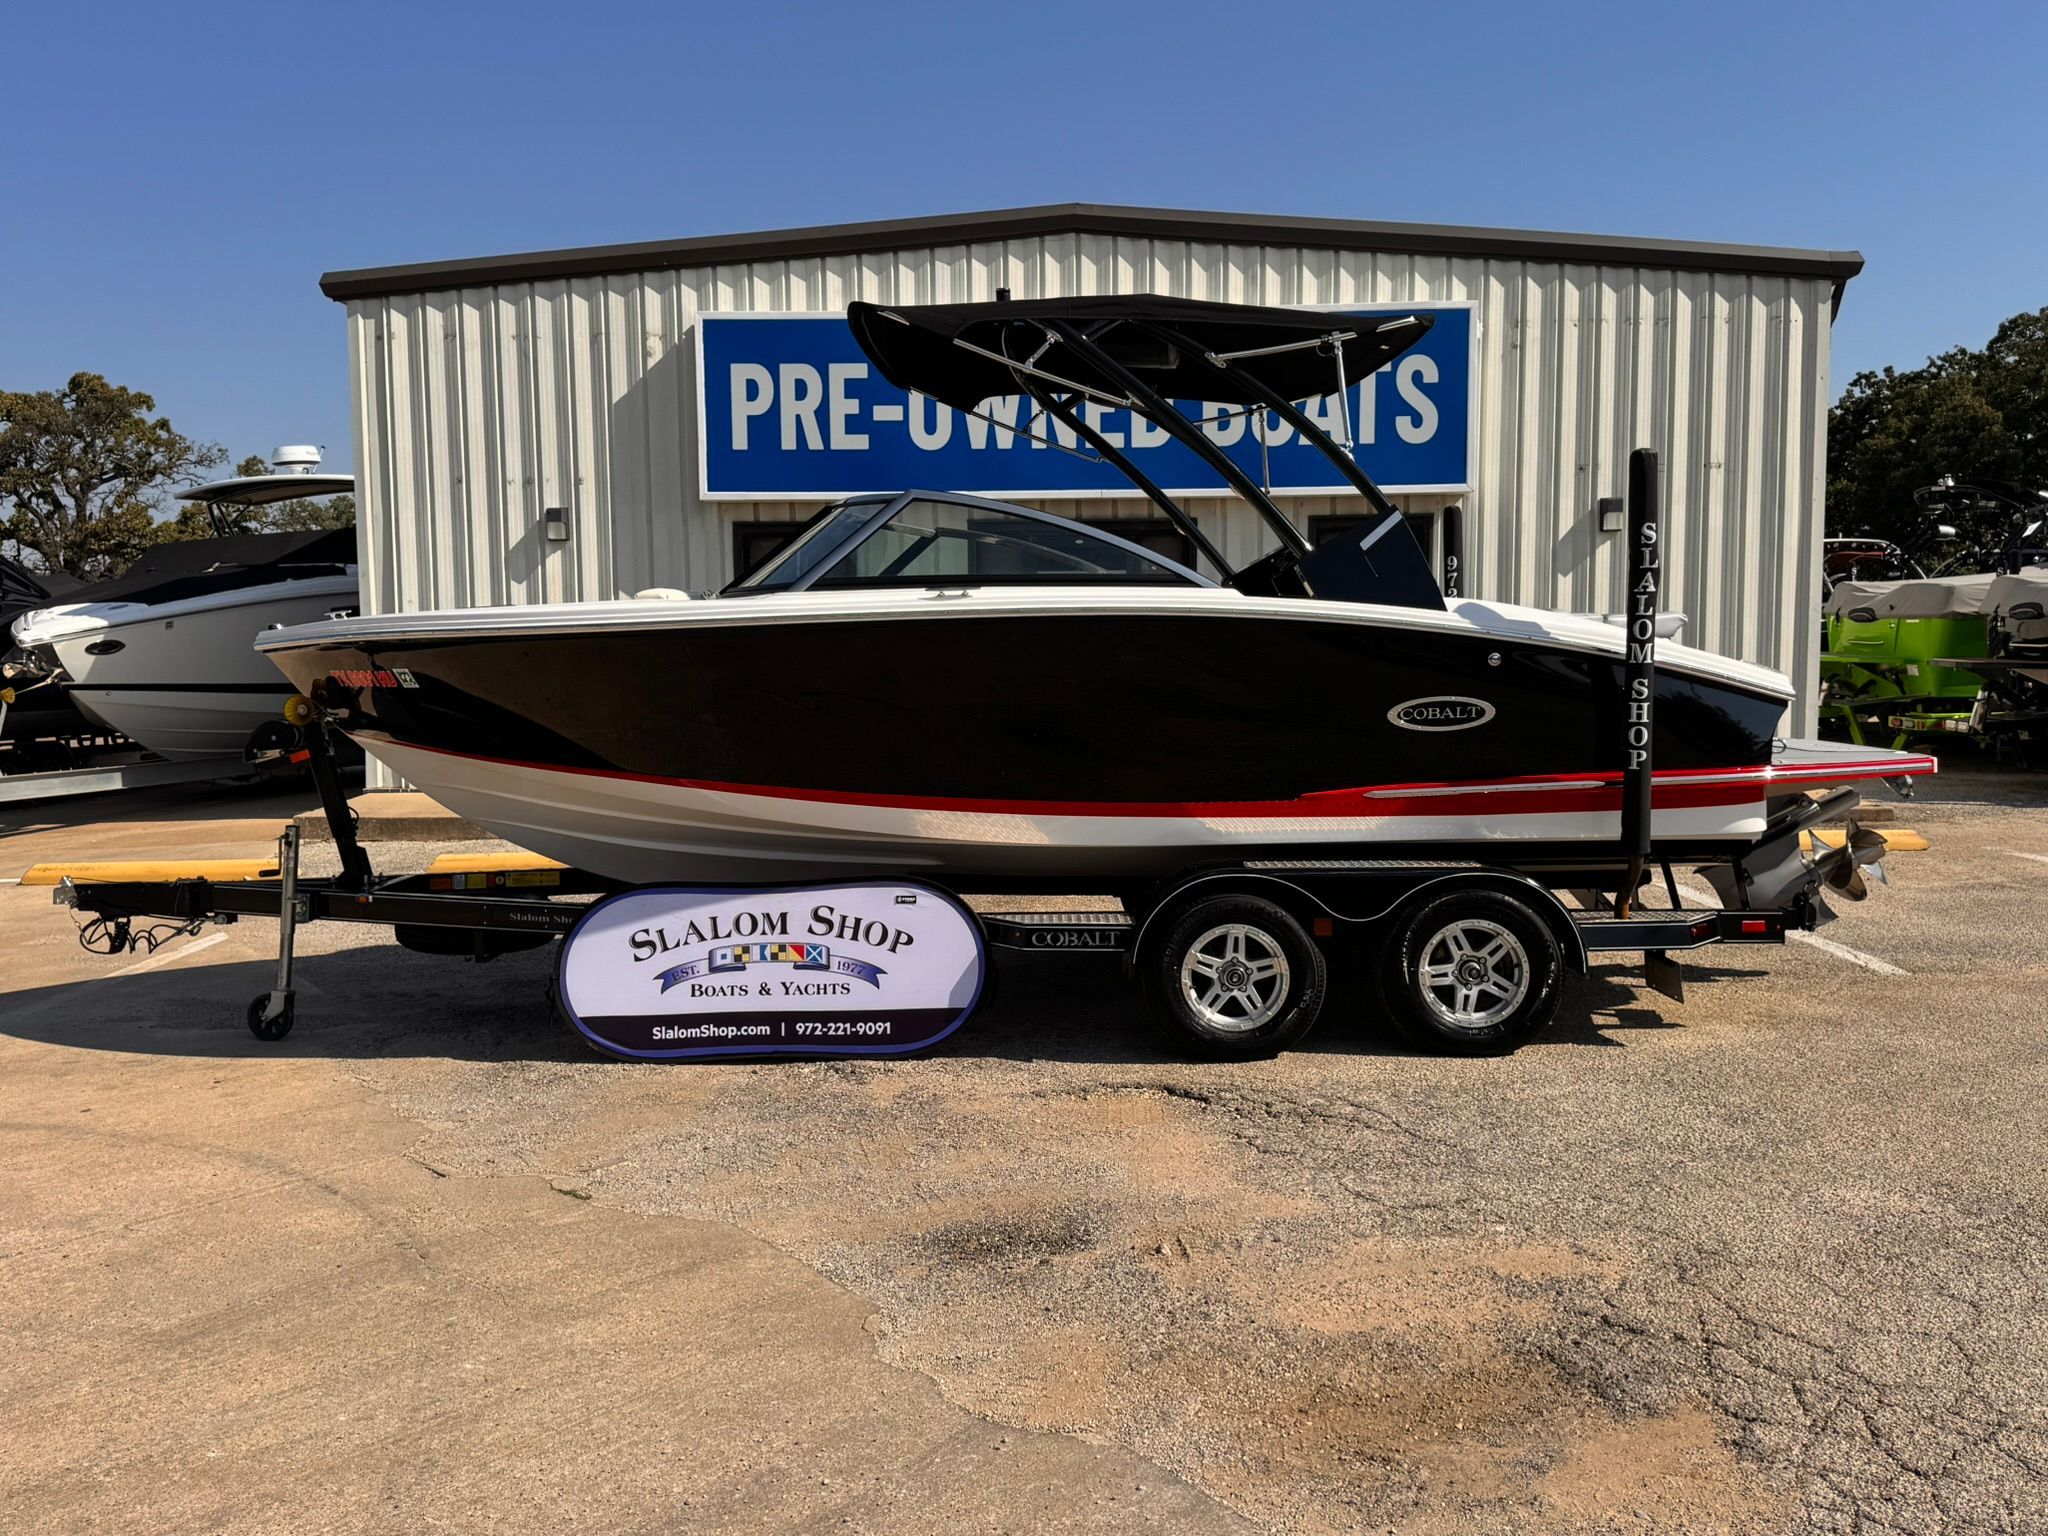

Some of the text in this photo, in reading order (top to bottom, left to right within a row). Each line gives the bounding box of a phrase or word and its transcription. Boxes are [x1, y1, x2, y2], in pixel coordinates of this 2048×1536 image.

[1628, 522, 1659, 770] SLALOM SHOP
[1400, 706, 1480, 720] COBALT
[509, 912, 550, 923] Slalom
[629, 905, 914, 962] SLALOM SHOP
[1032, 932, 1120, 946] COBALT
[672, 960, 866, 982] EST. 1977
[690, 981, 851, 998] BOATS & YACHTS
[652, 1022, 892, 1041] SlalomShop.com 972-221-9091
